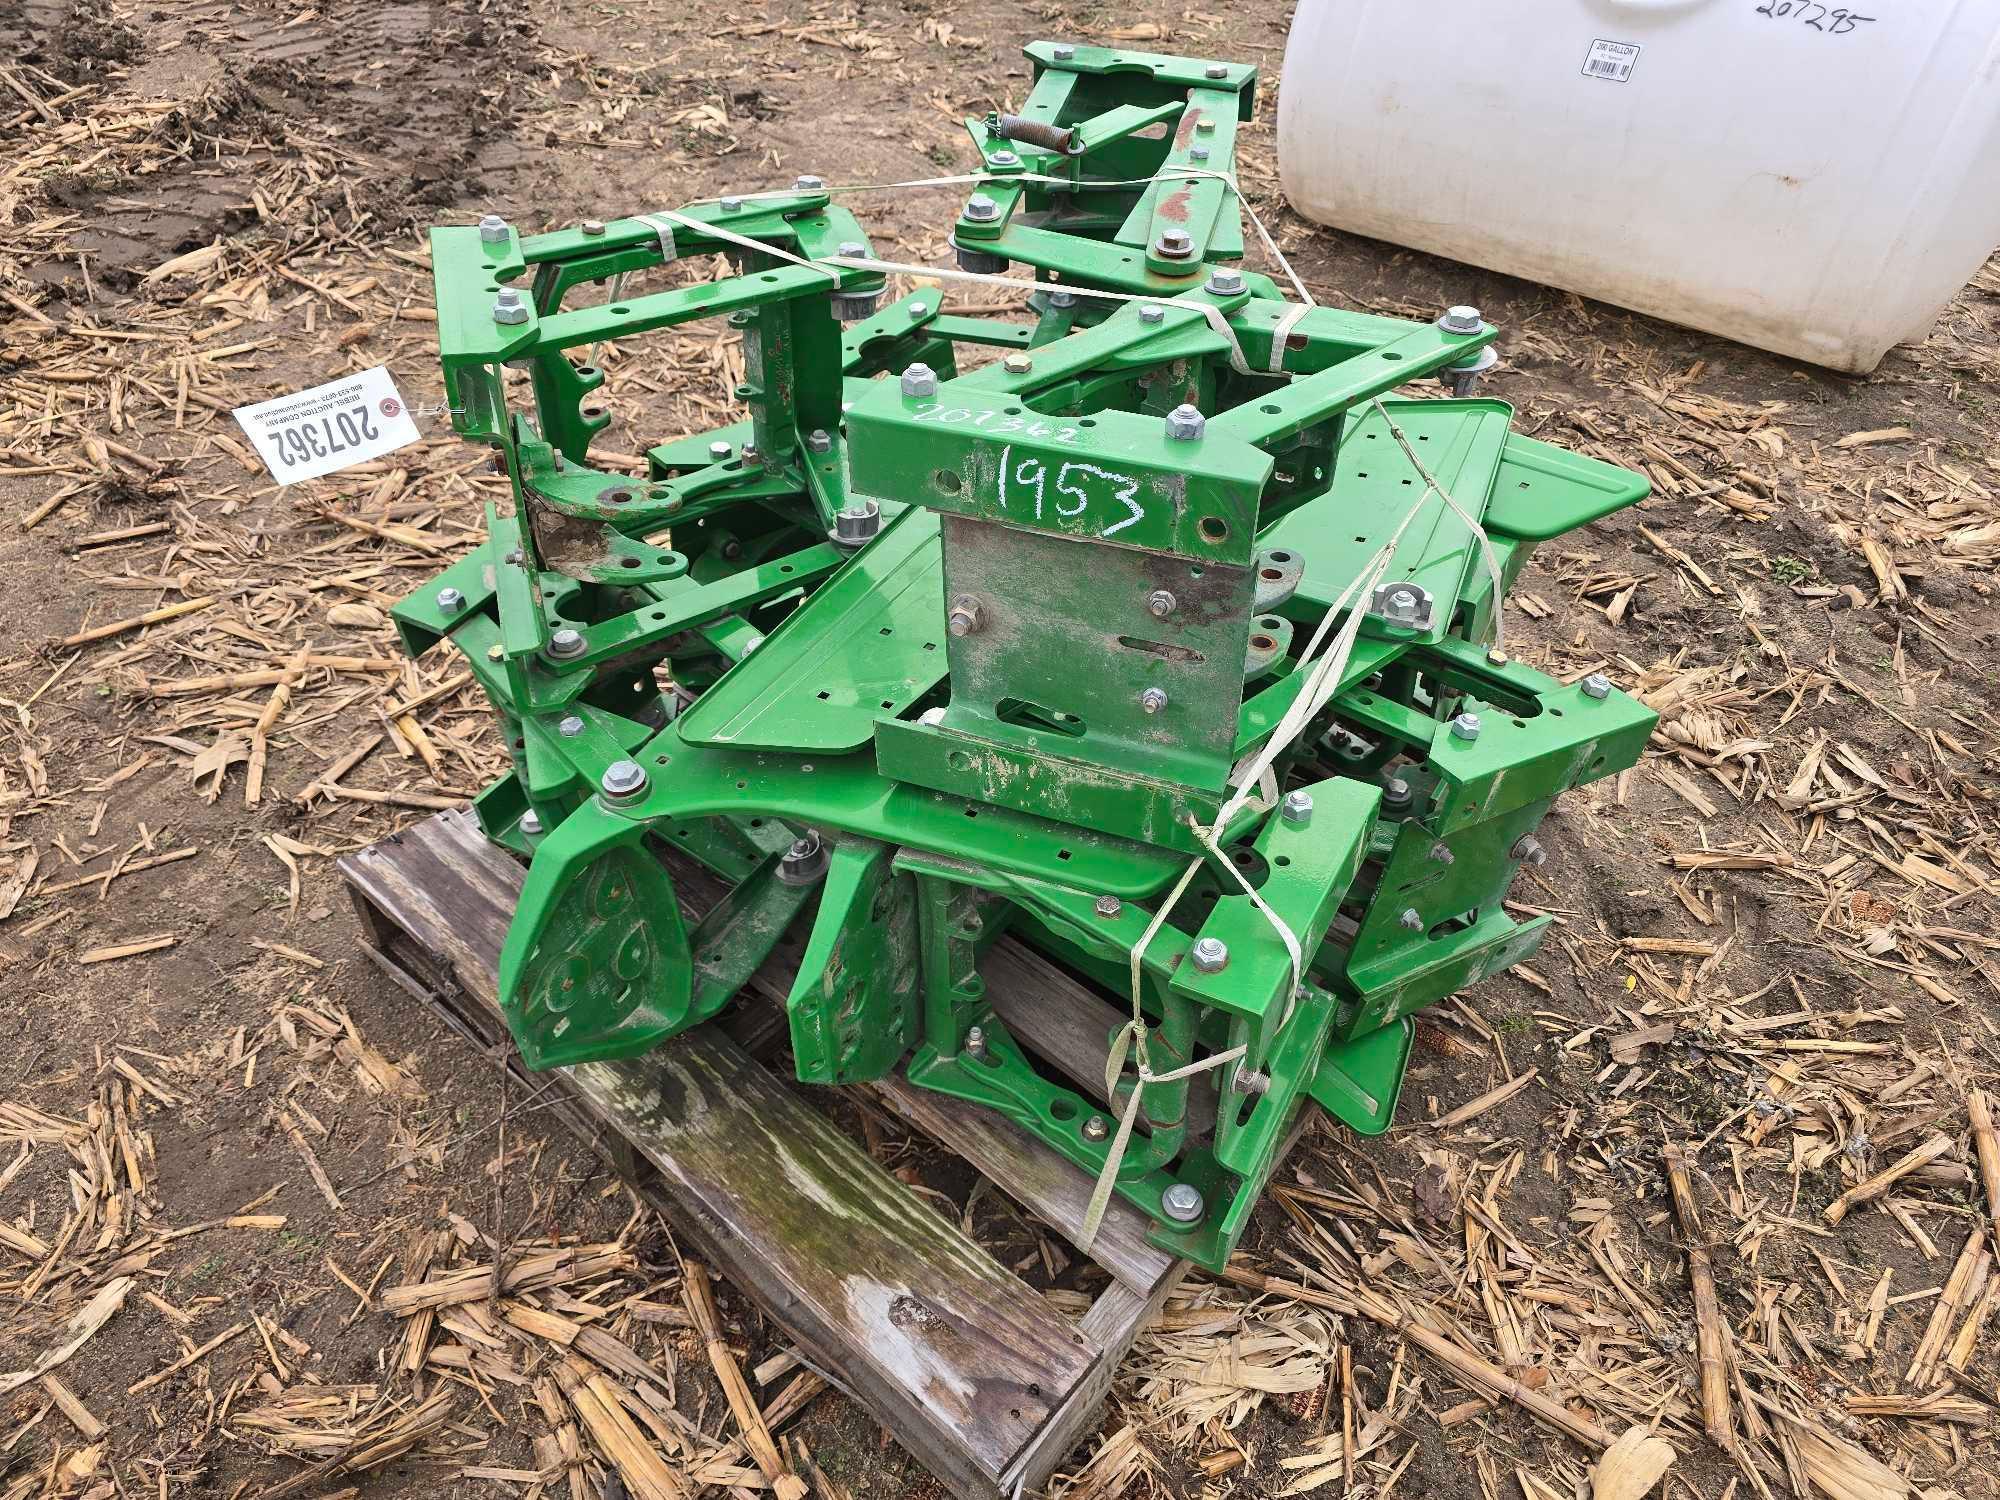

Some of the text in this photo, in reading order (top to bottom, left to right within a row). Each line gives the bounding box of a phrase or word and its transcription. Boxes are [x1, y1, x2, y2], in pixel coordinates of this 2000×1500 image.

[1756, 0, 1877, 33] 207295
[1608, 44, 1634, 56] GALLON
[265, 393, 361, 427] REBEL AUCTION COMPANY
[911, 403, 1081, 443] 207362
[267, 404, 379, 467] 207362
[997, 444, 1145, 537] 1953
